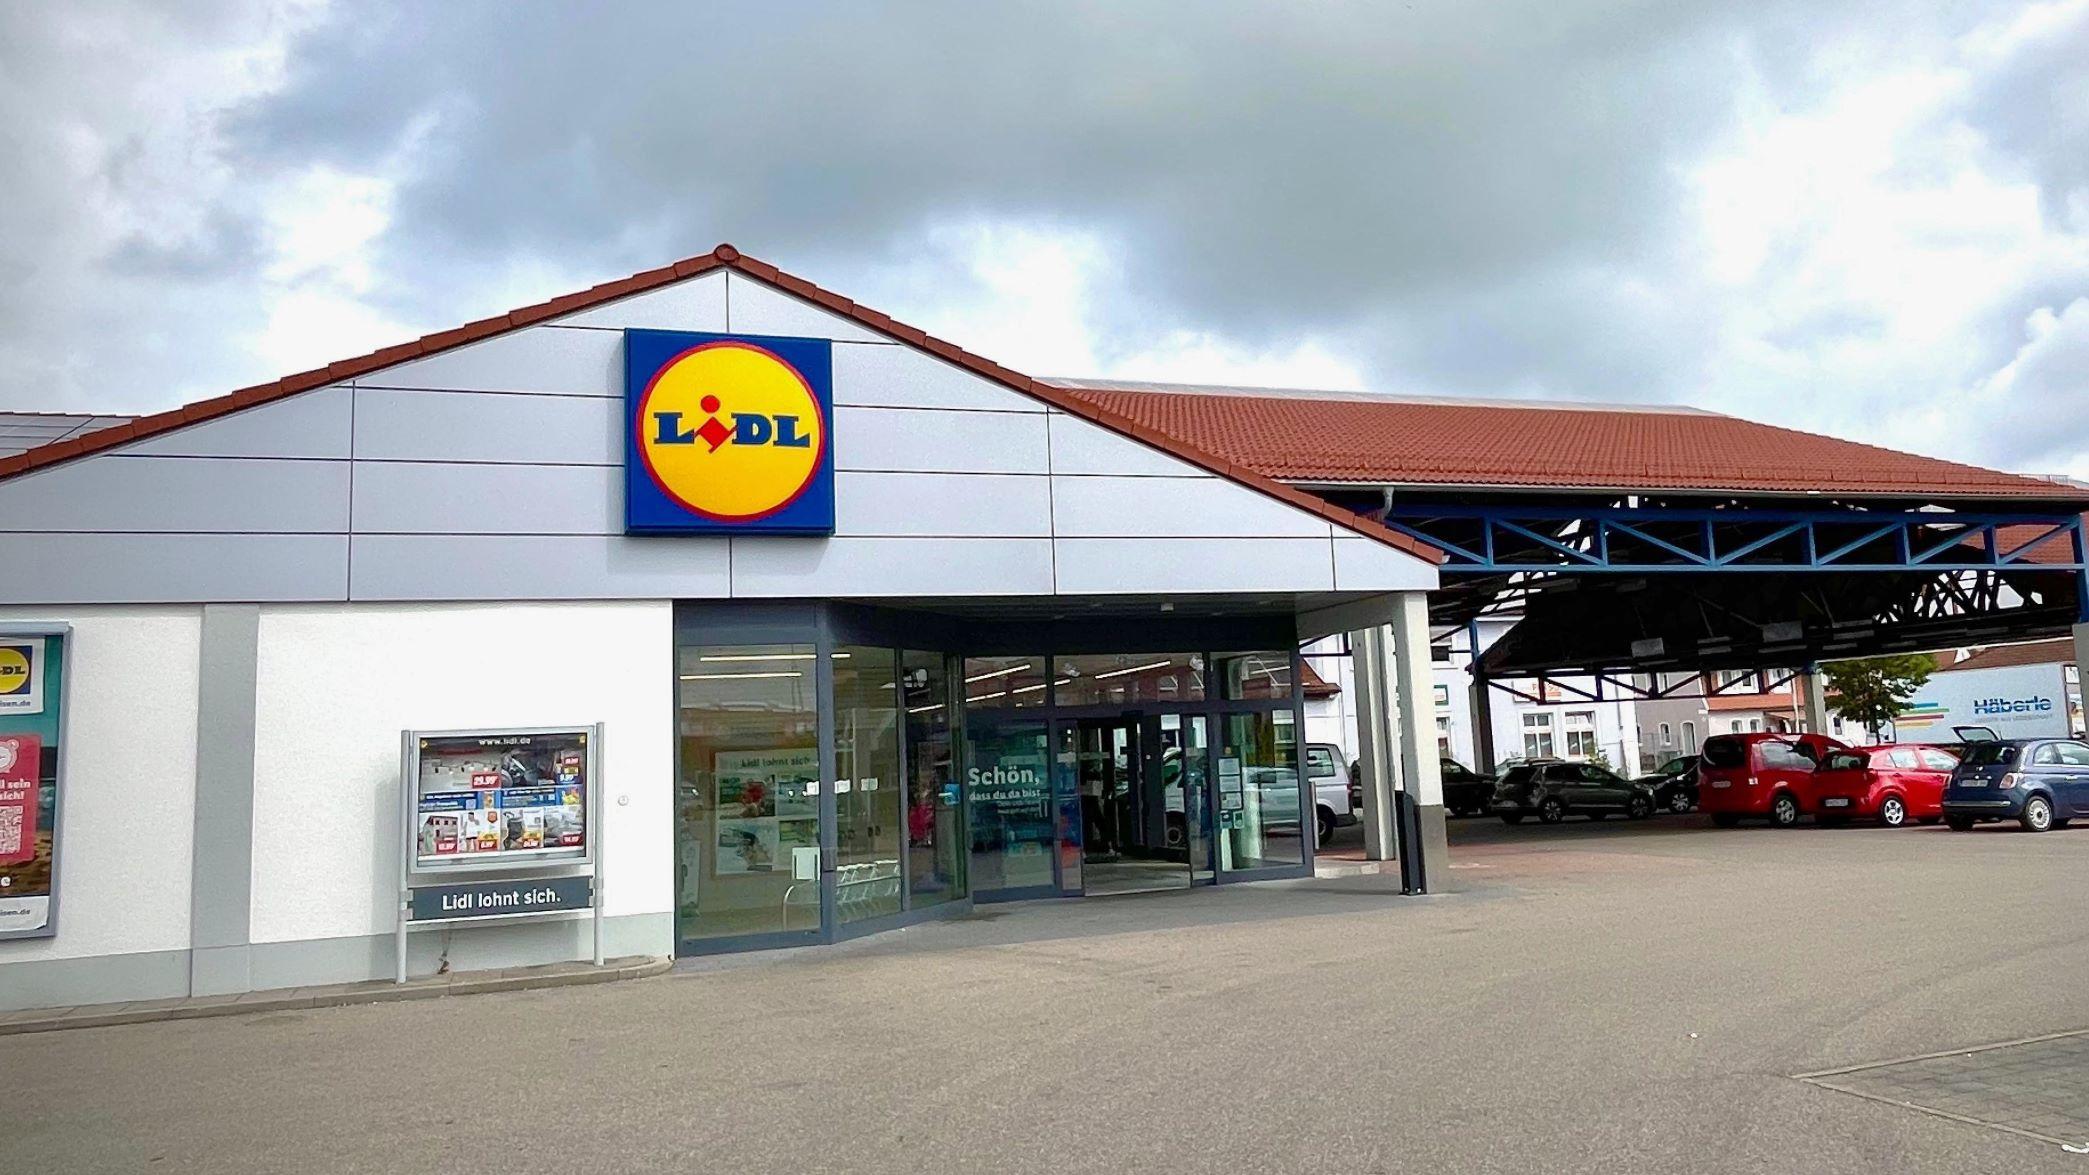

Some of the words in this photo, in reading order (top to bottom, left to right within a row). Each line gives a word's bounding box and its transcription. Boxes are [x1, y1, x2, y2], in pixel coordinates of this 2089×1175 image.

[1974, 696, 2051, 714] Häberle
[8, 778, 31, 788] sein
[968, 765, 1040, 786] Schön,
[969, 791, 991, 801] dass
[993, 790, 1006, 799] du
[1008, 789, 1020, 798] da
[1022, 788, 1040, 798] bist
[442, 893, 472, 911] Lidl
[478, 891, 520, 908] lohnt
[523, 888, 561, 904] sich.
